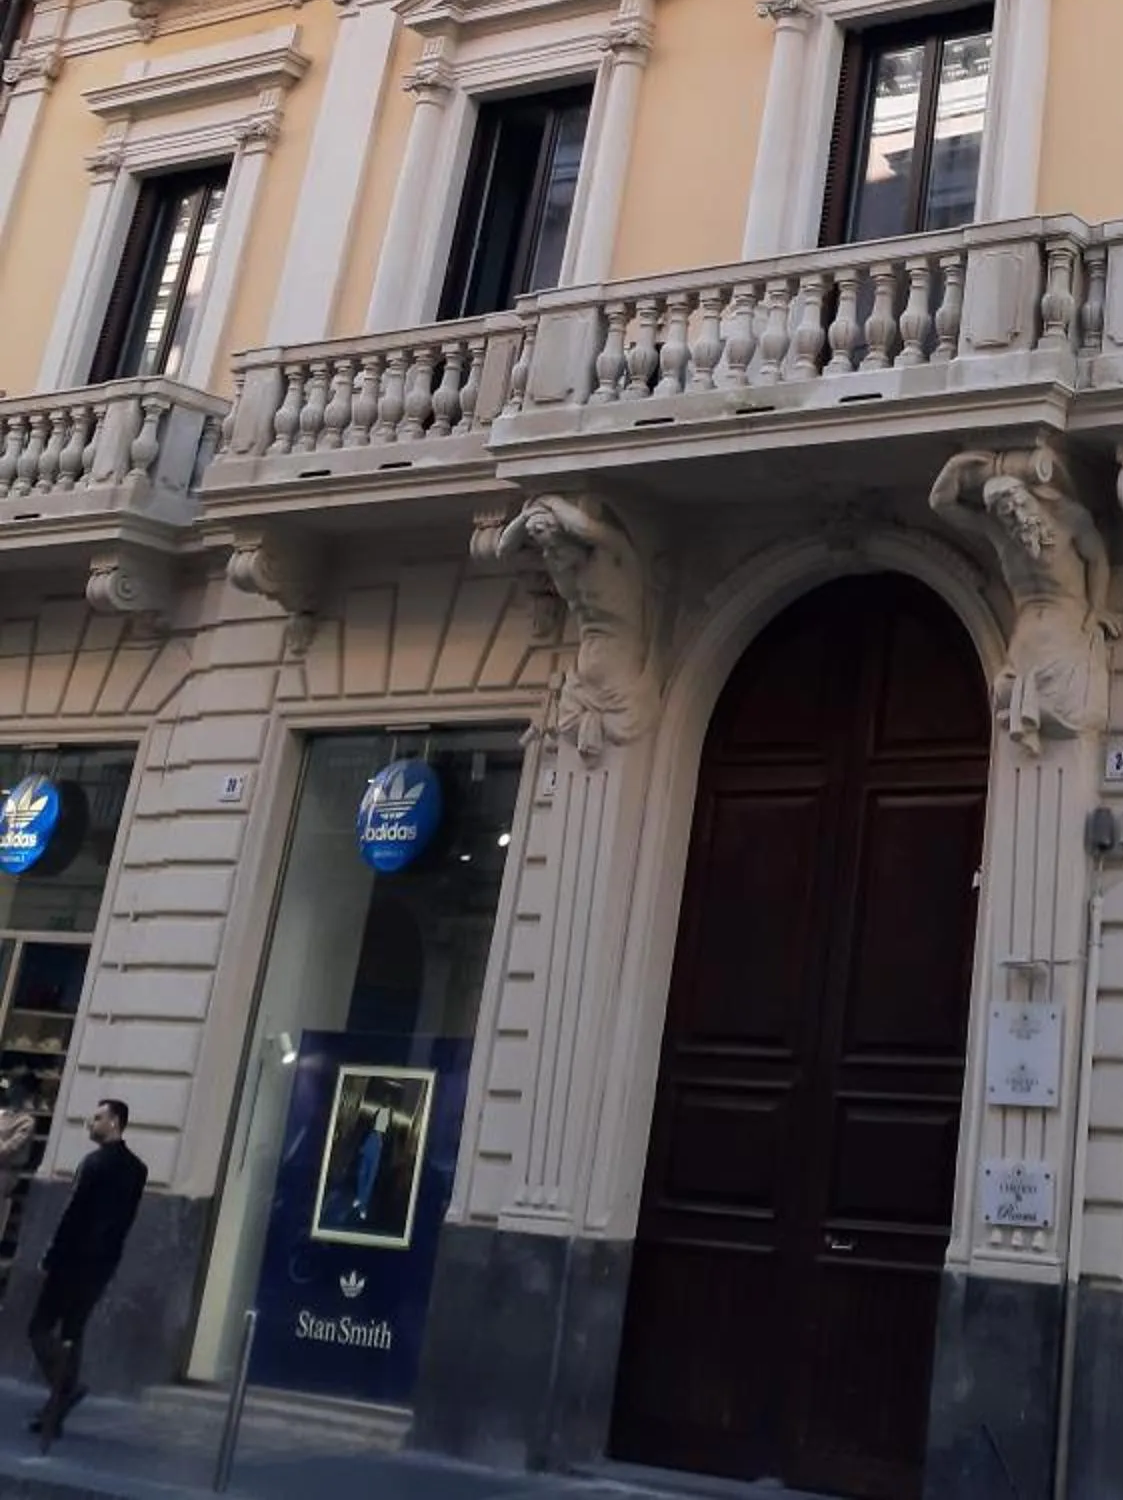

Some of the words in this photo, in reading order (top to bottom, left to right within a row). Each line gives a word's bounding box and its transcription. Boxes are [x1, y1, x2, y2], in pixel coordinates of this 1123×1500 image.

[365, 823, 417, 842] adidas
[296, 1310, 336, 1342] Stan
[337, 1316, 391, 1350] Smith
